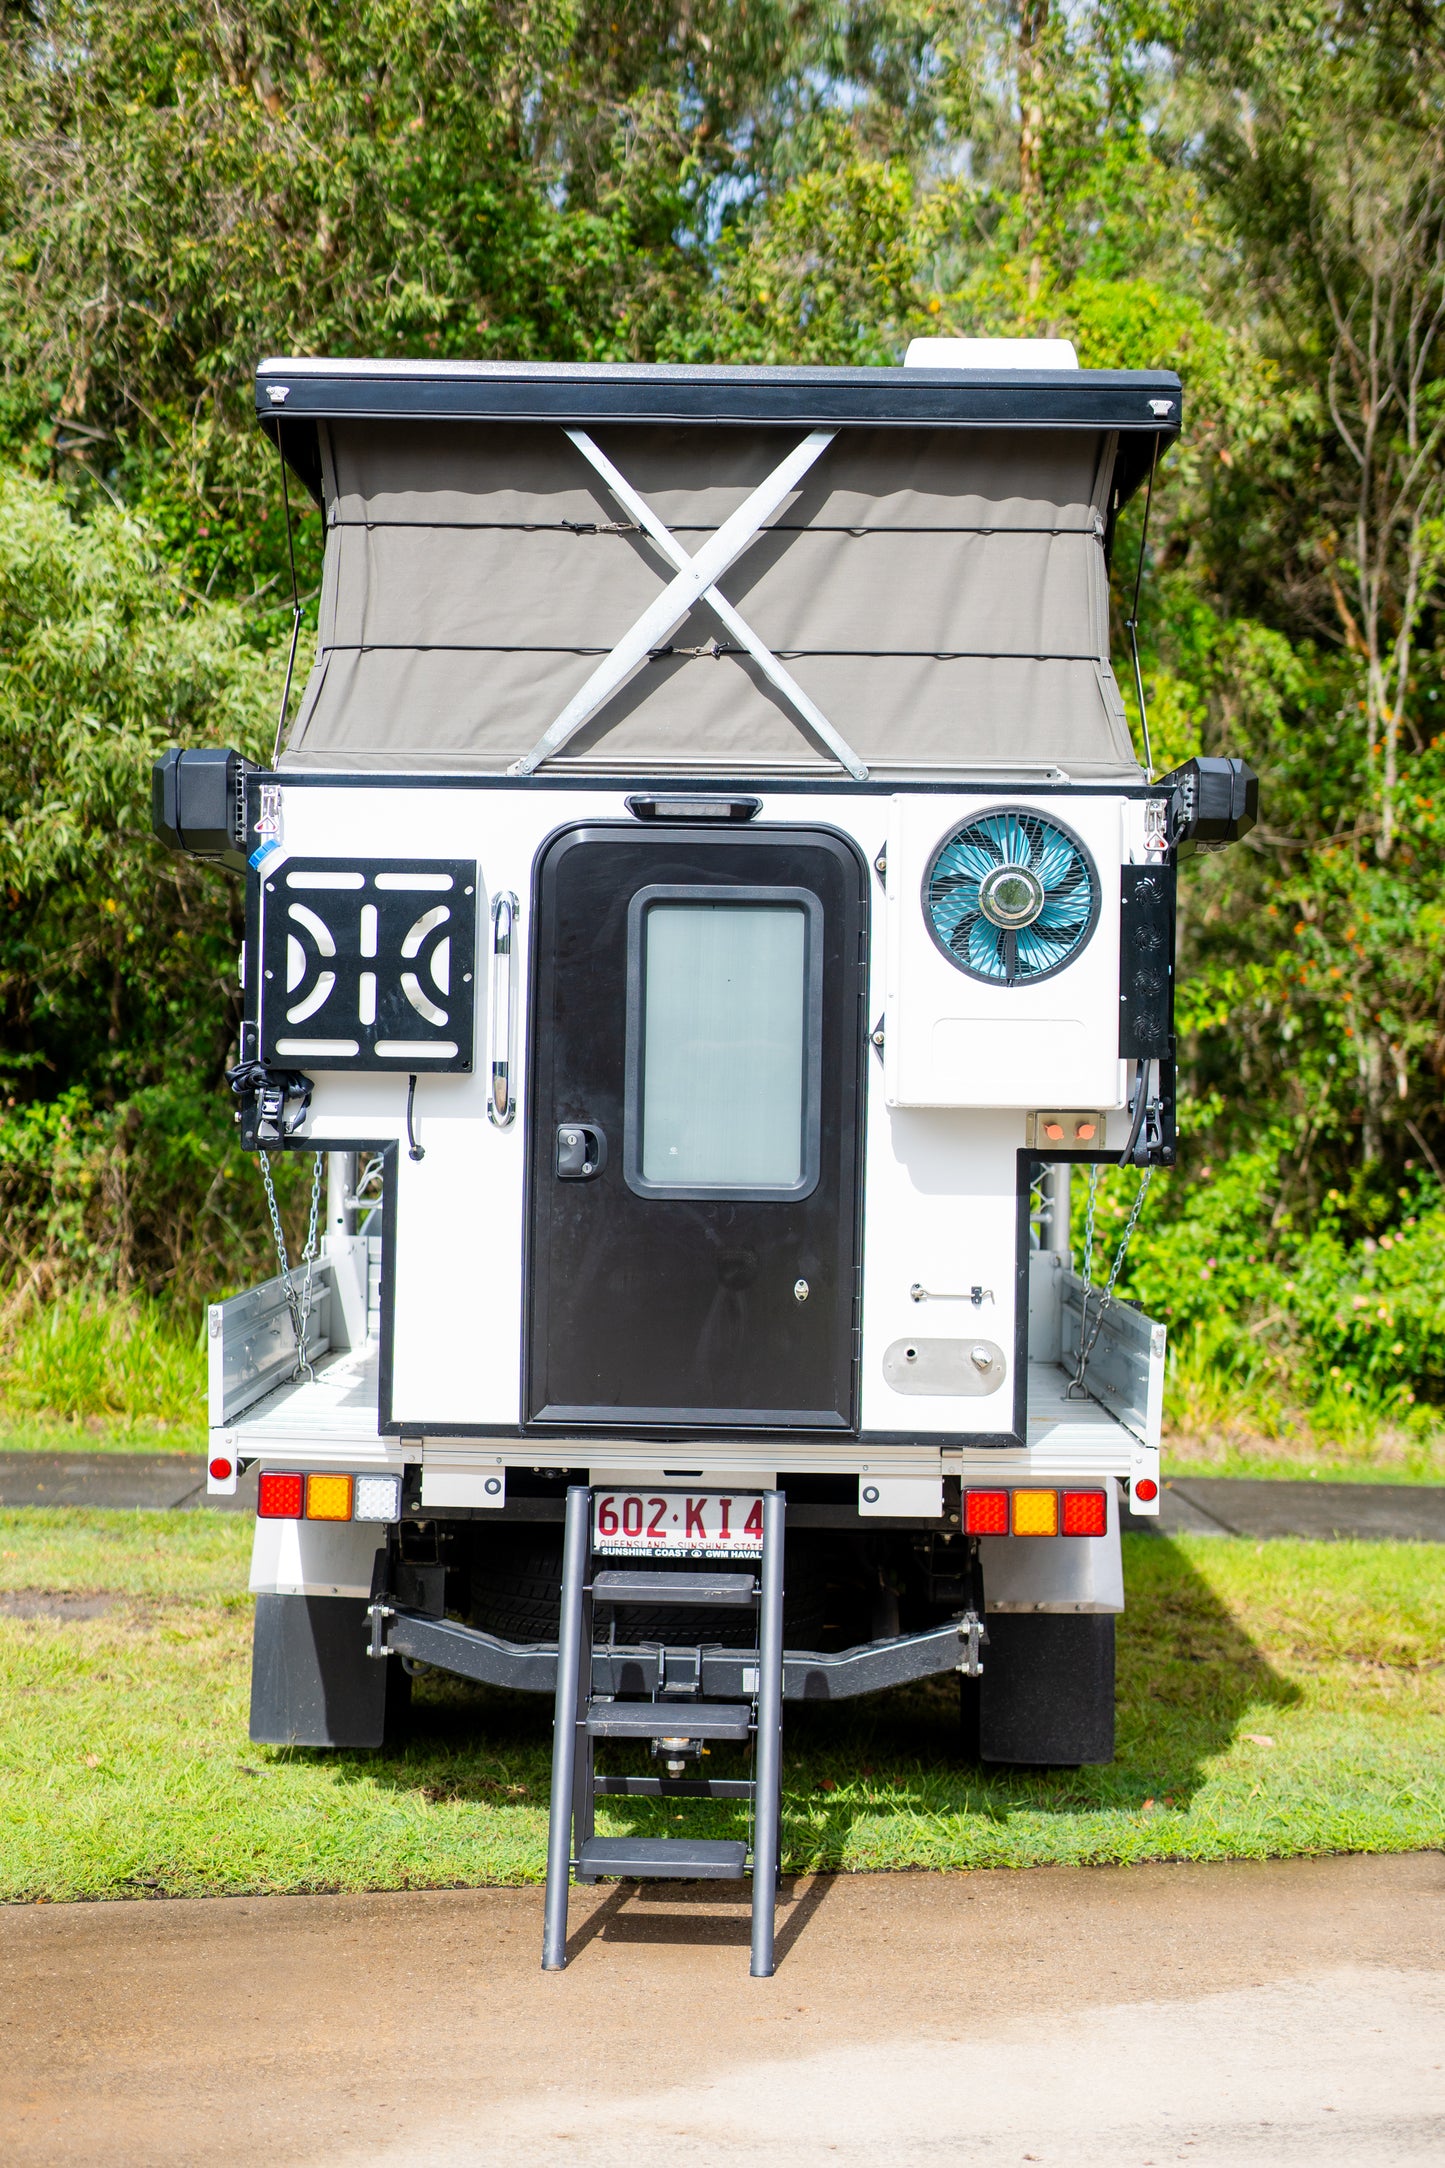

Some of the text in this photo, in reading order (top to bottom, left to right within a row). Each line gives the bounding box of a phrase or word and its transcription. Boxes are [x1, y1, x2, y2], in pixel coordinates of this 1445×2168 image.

[600, 1539, 666, 1548] QUEENSLAND
[677, 1541, 728, 1549] SUNSHINE
[602, 1547, 762, 1558] SUNSHINE COAST GWM HAVAL
